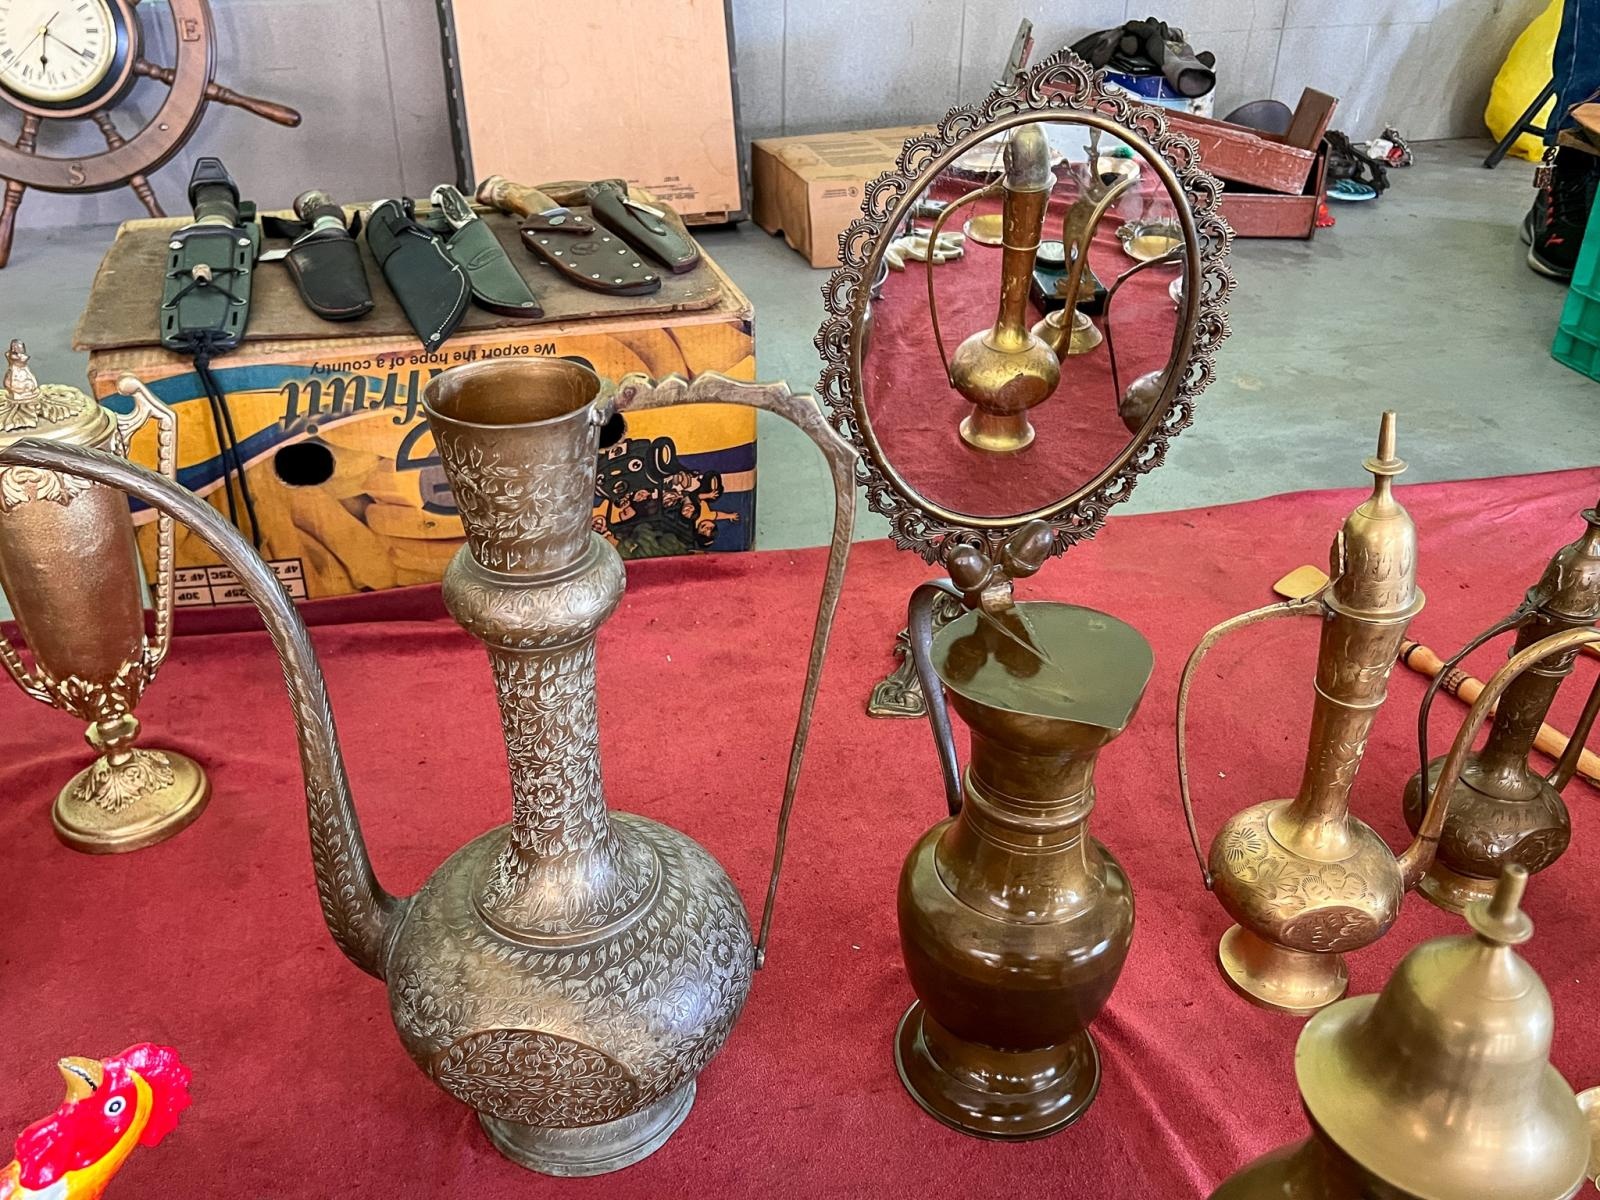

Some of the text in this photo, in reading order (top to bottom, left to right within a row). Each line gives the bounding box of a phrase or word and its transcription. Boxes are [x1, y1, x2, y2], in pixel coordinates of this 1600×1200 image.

[179, 18, 201, 42] E
[68, 163, 87, 186] S
[309, 343, 556, 377] We export the hope of a country
